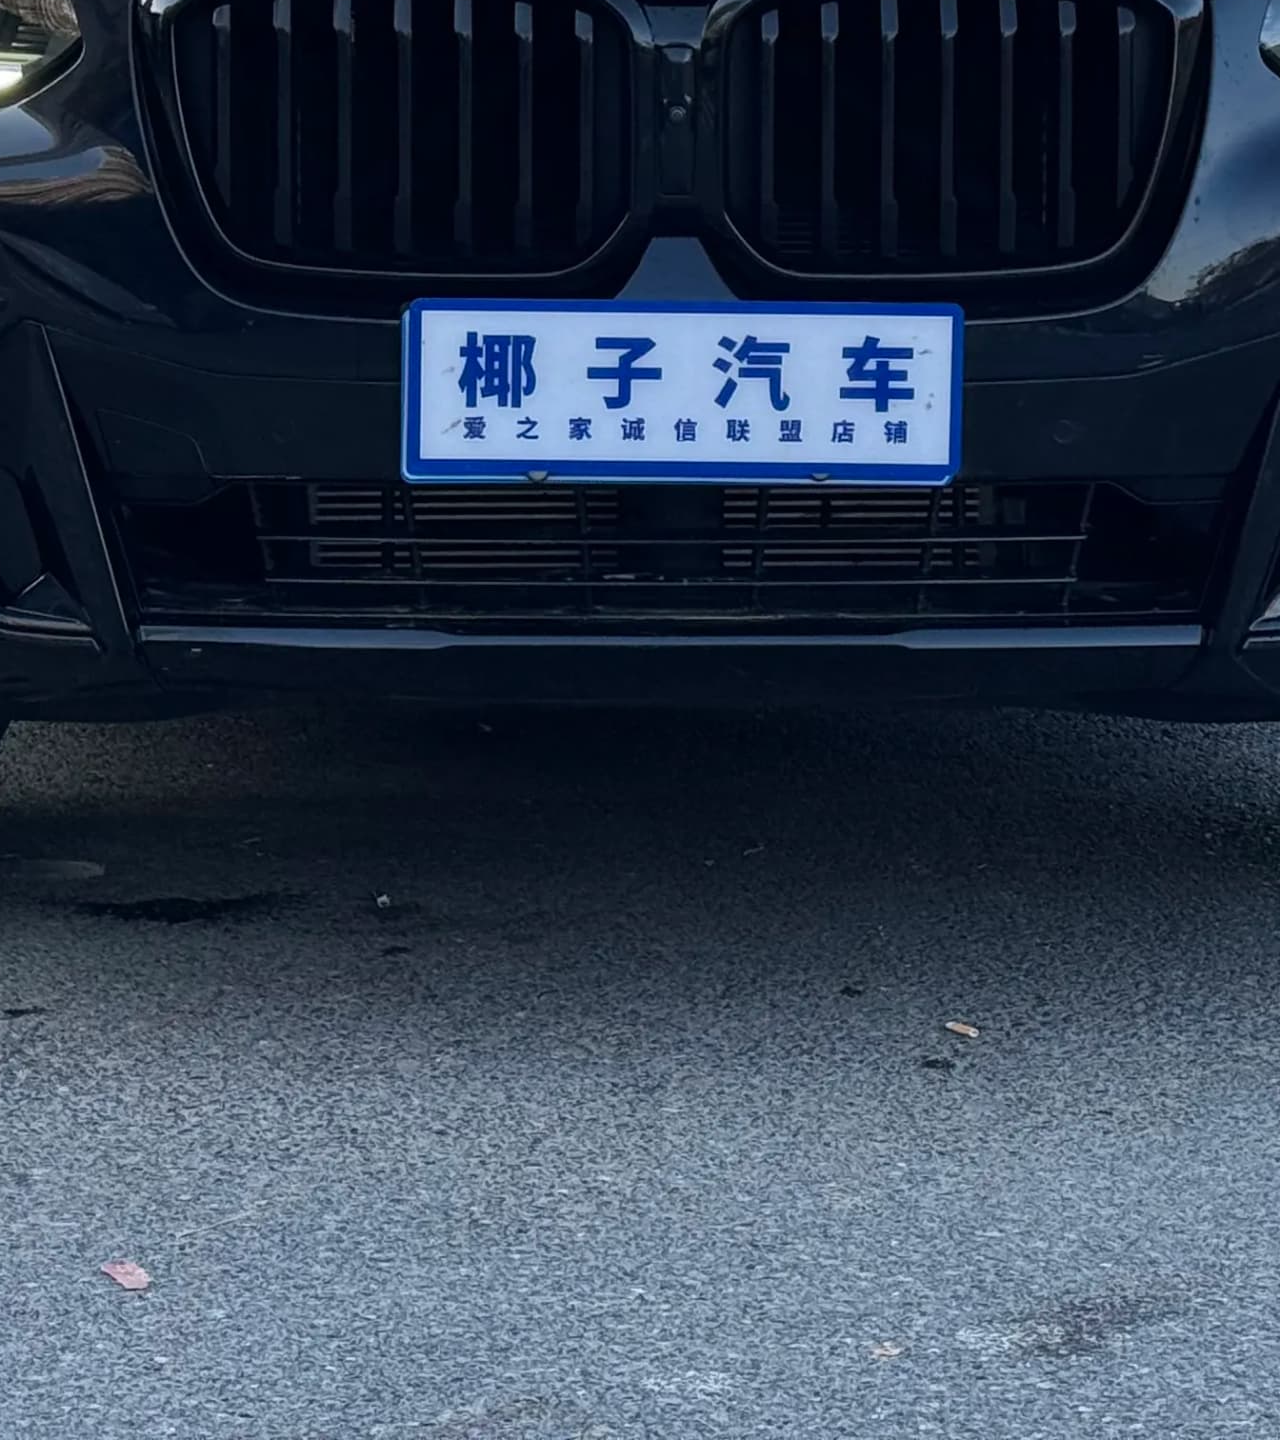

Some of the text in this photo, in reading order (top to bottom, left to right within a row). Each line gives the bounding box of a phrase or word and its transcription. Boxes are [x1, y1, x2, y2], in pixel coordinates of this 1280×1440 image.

[458, 331, 915, 412] 椰子汽车
[463, 415, 908, 445] 爱之家诚信联盟店铺
